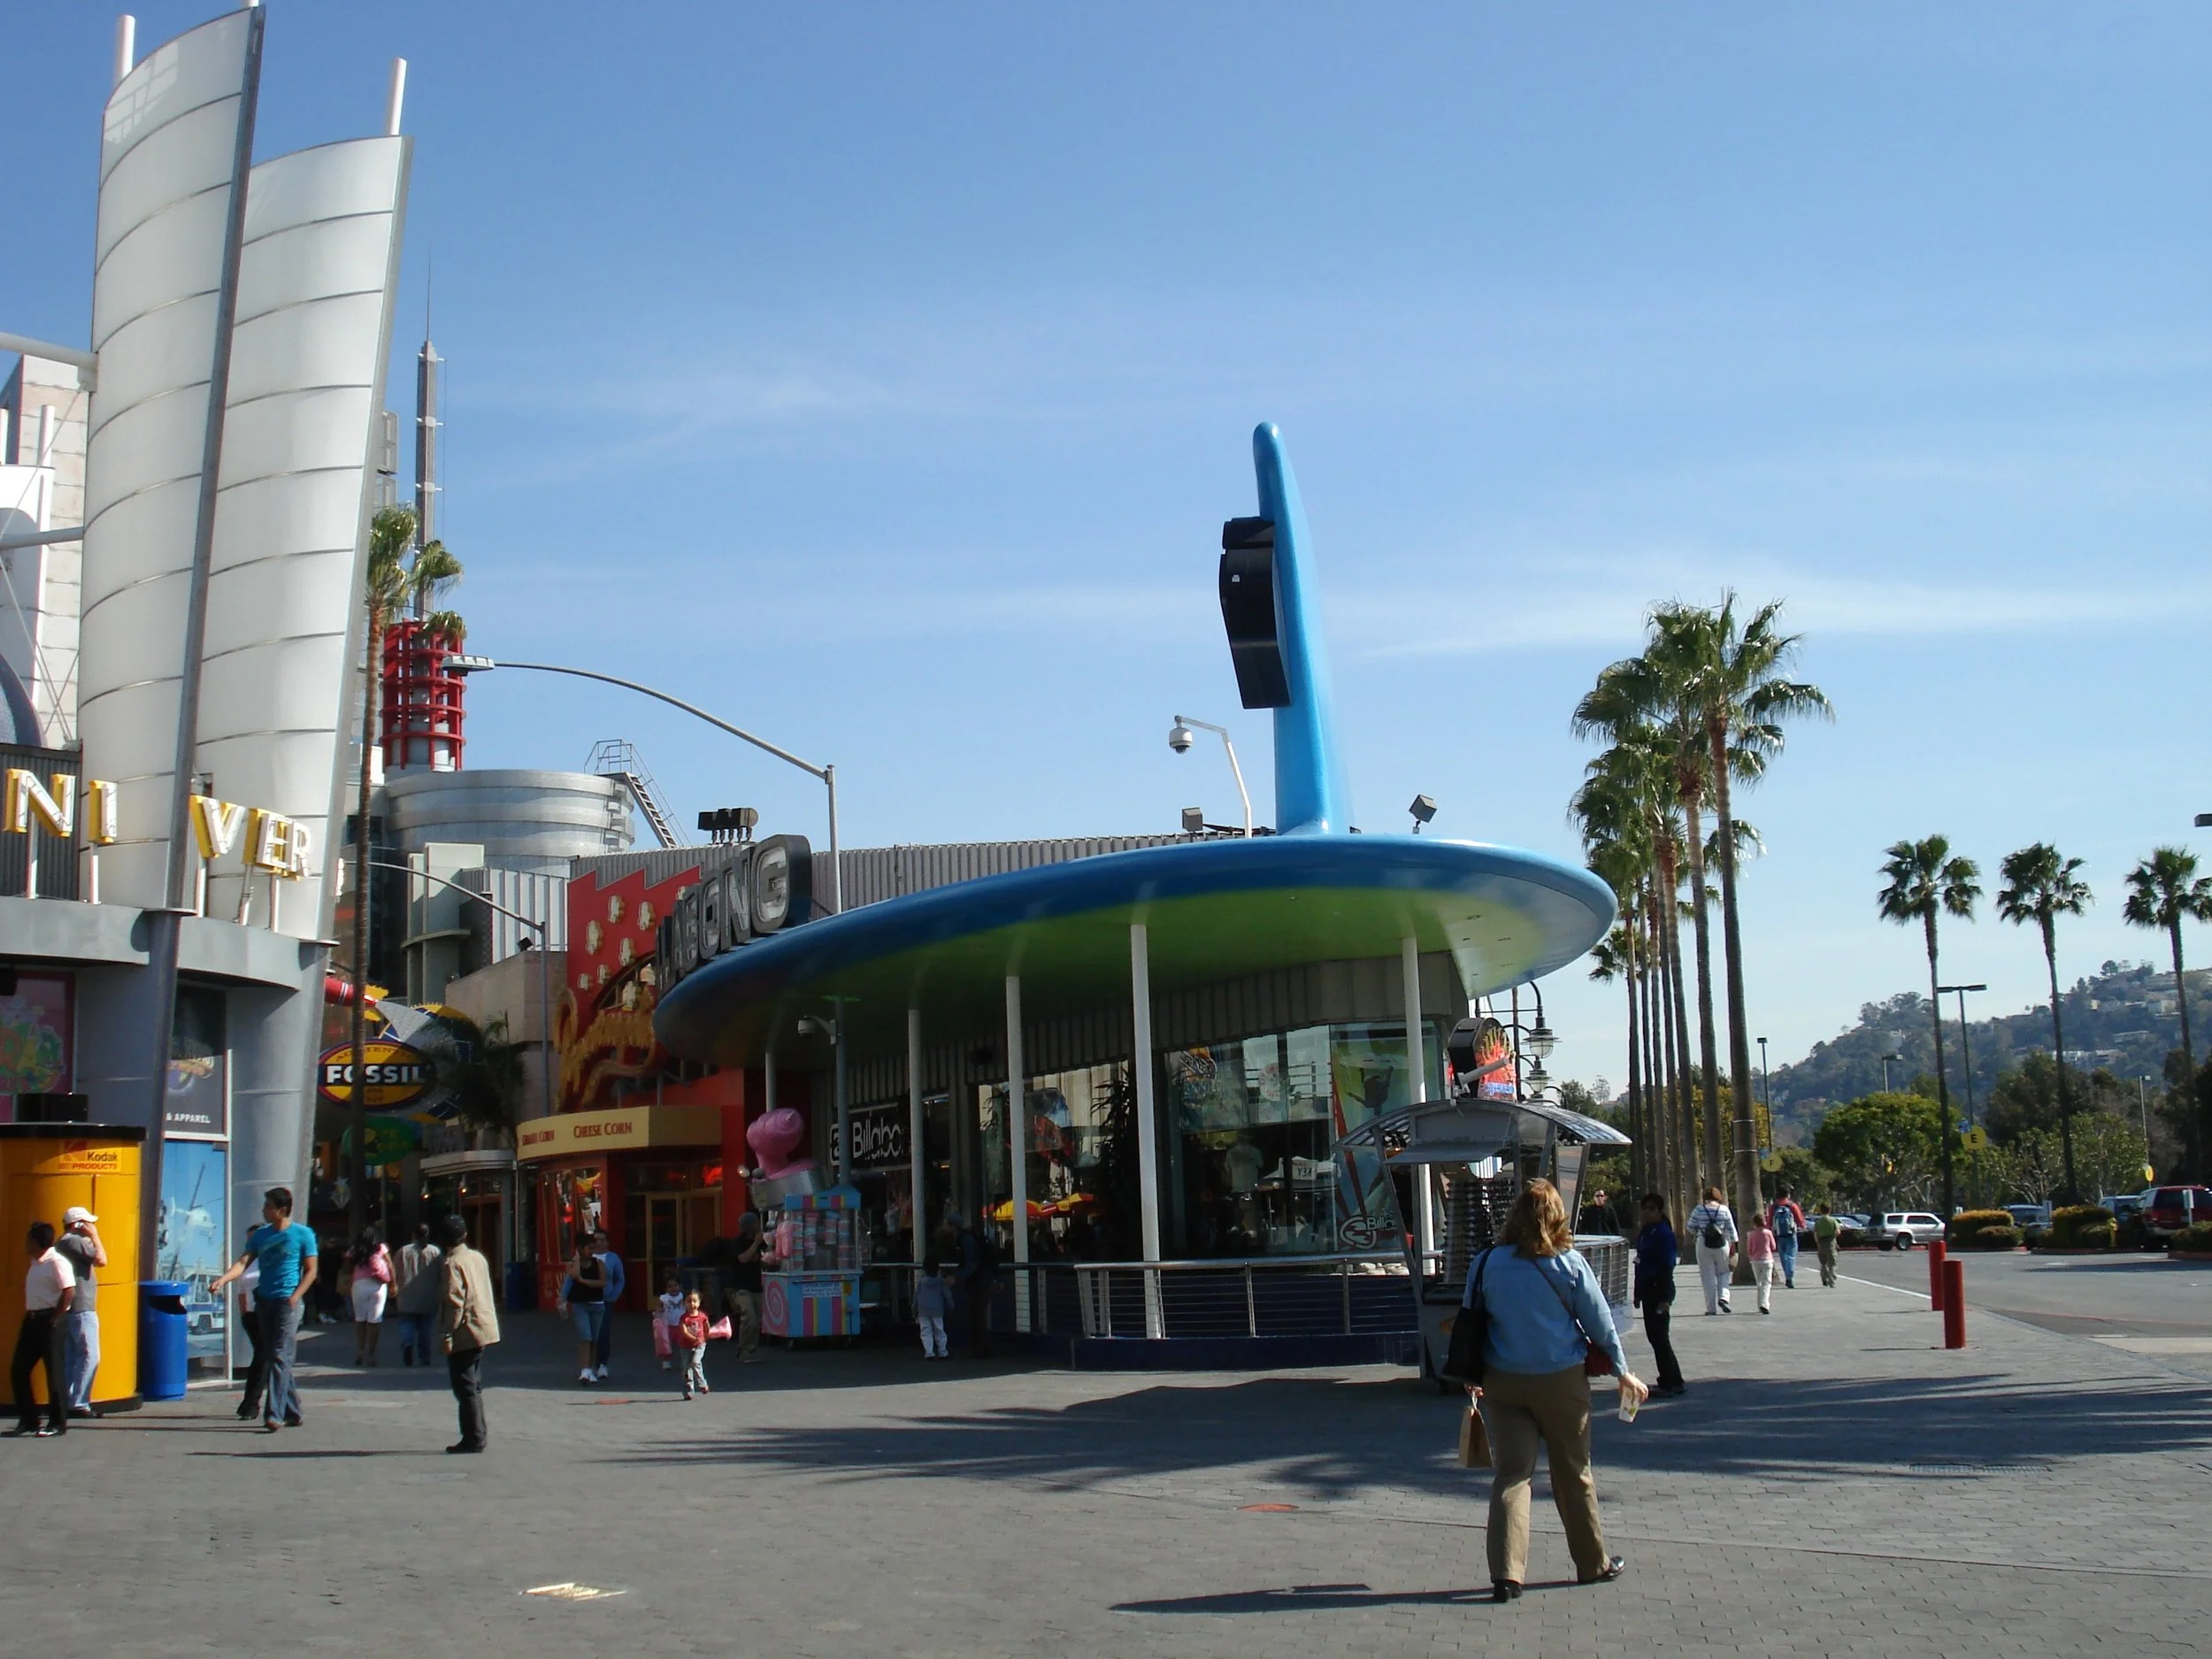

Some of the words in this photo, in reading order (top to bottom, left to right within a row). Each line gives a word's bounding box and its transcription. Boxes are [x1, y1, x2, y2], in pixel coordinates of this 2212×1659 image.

[173, 1113, 211, 1124] APPAREL
[573, 1124, 602, 1139] CHEESE
[604, 1121, 632, 1136] CORN
[1970, 1133, 1978, 1143] E
[87, 1151, 118, 1162] Kodak
